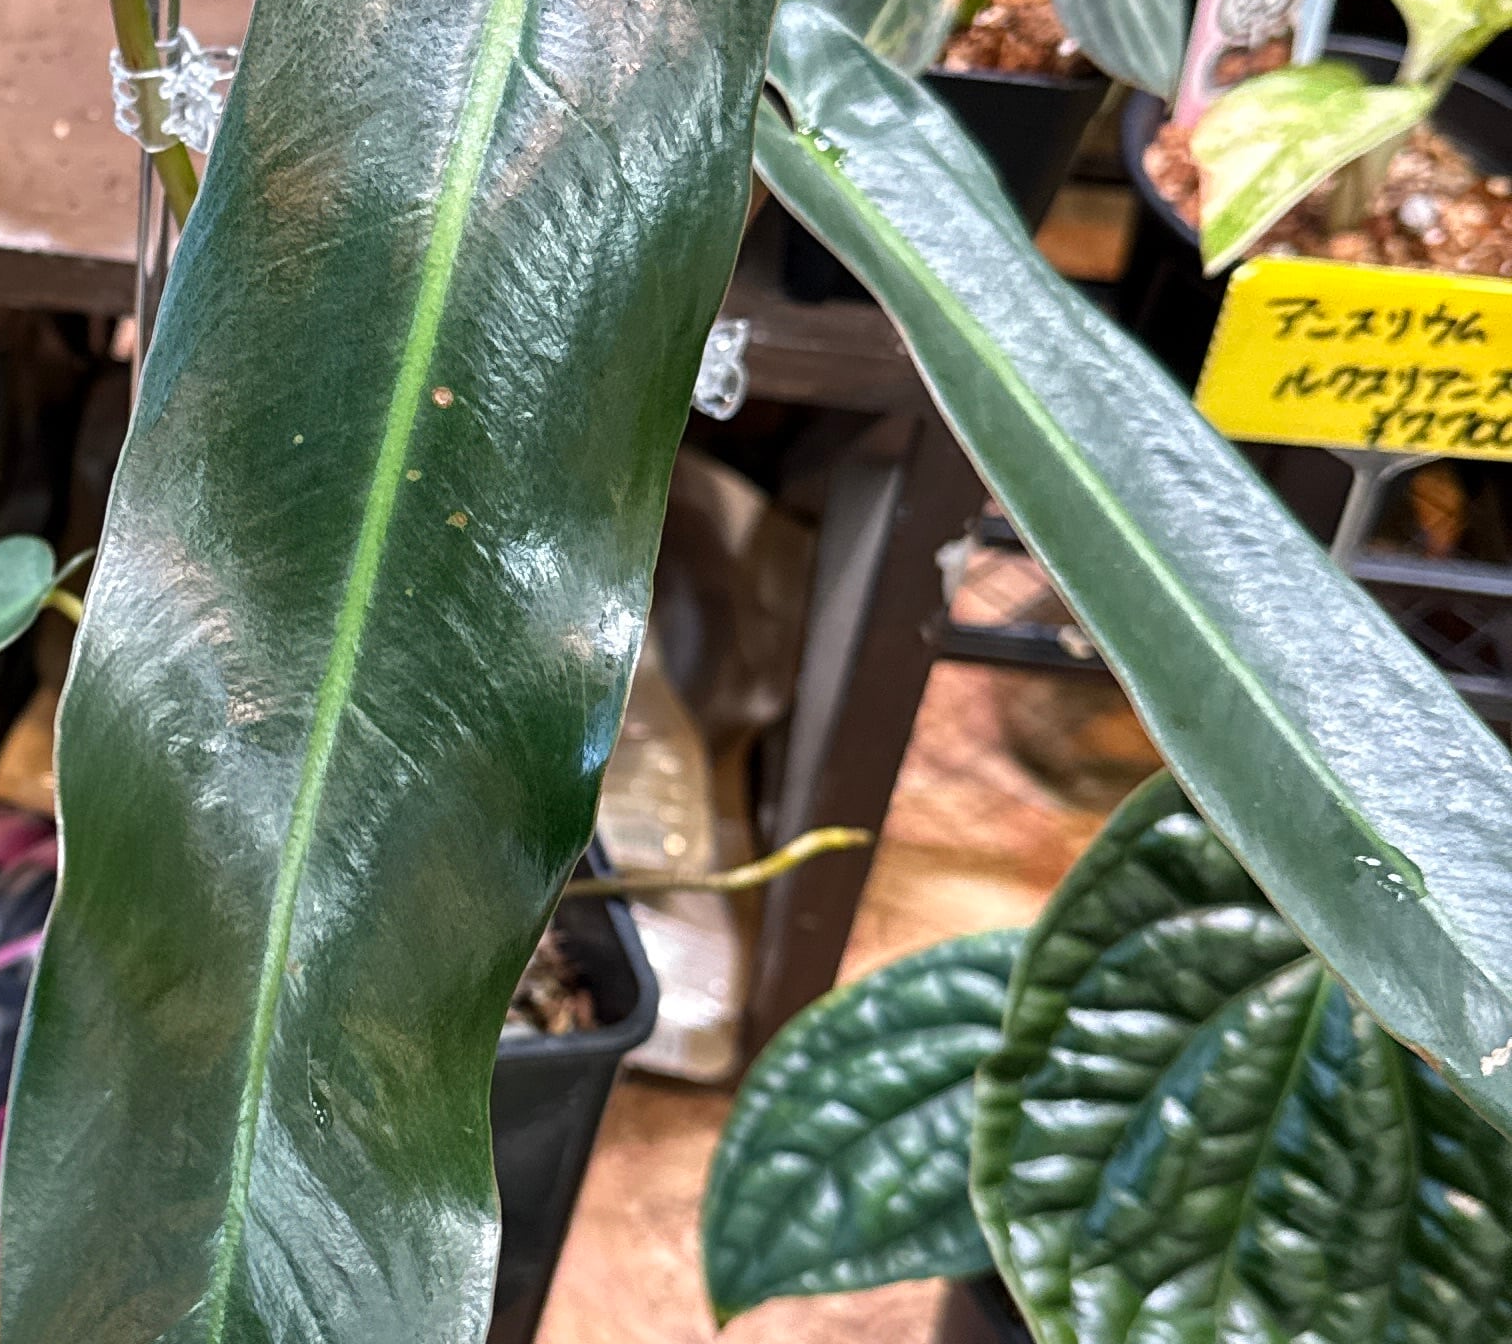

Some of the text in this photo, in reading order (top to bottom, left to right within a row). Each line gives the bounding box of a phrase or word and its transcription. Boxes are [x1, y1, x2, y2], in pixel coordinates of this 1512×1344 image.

[1264, 296, 1488, 347] アンスリウム
